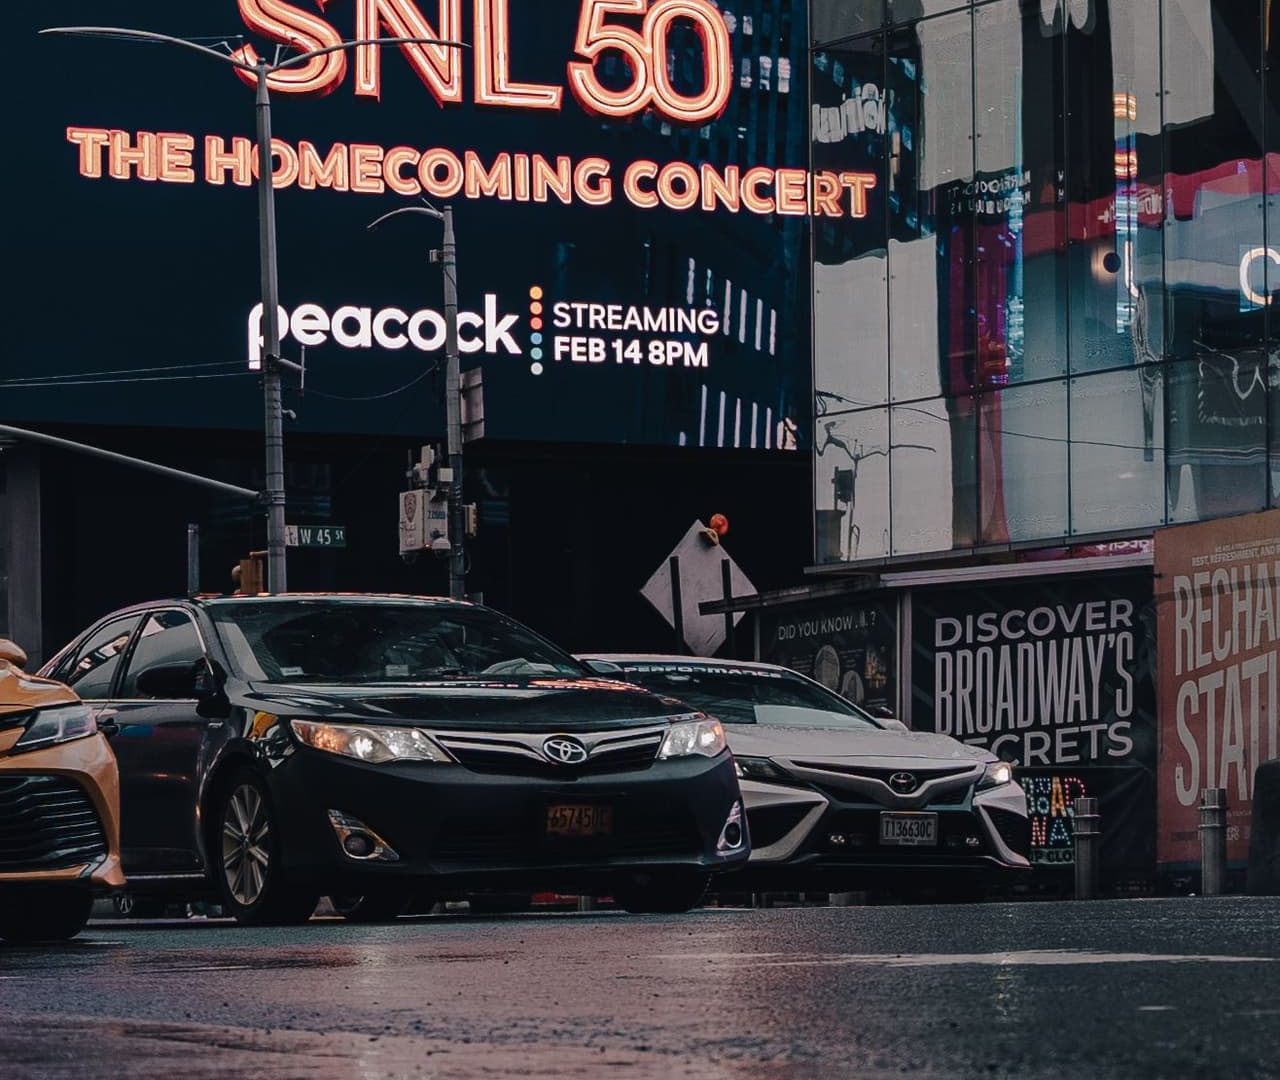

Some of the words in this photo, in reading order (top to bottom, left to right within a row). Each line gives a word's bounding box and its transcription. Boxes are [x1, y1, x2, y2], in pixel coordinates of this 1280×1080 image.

[65, 126, 194, 184] THE
[205, 133, 614, 208] HOMECOMING
[621, 160, 878, 219] CONCERT
[247, 293, 523, 371] peacock
[552, 302, 720, 335] STREAMING
[553, 336, 607, 363] FEB
[611, 339, 643, 365] 14
[647, 340, 709, 367] 8PM
[299, 528, 312, 545] W
[316, 528, 332, 545] 45
[778, 624, 796, 641] DID
[798, 620, 820, 637] YOU
[934, 599, 1134, 648] DISCOVER
[934, 631, 1135, 737] BROADWAY'S
[884, 819, 933, 839] T136630C
